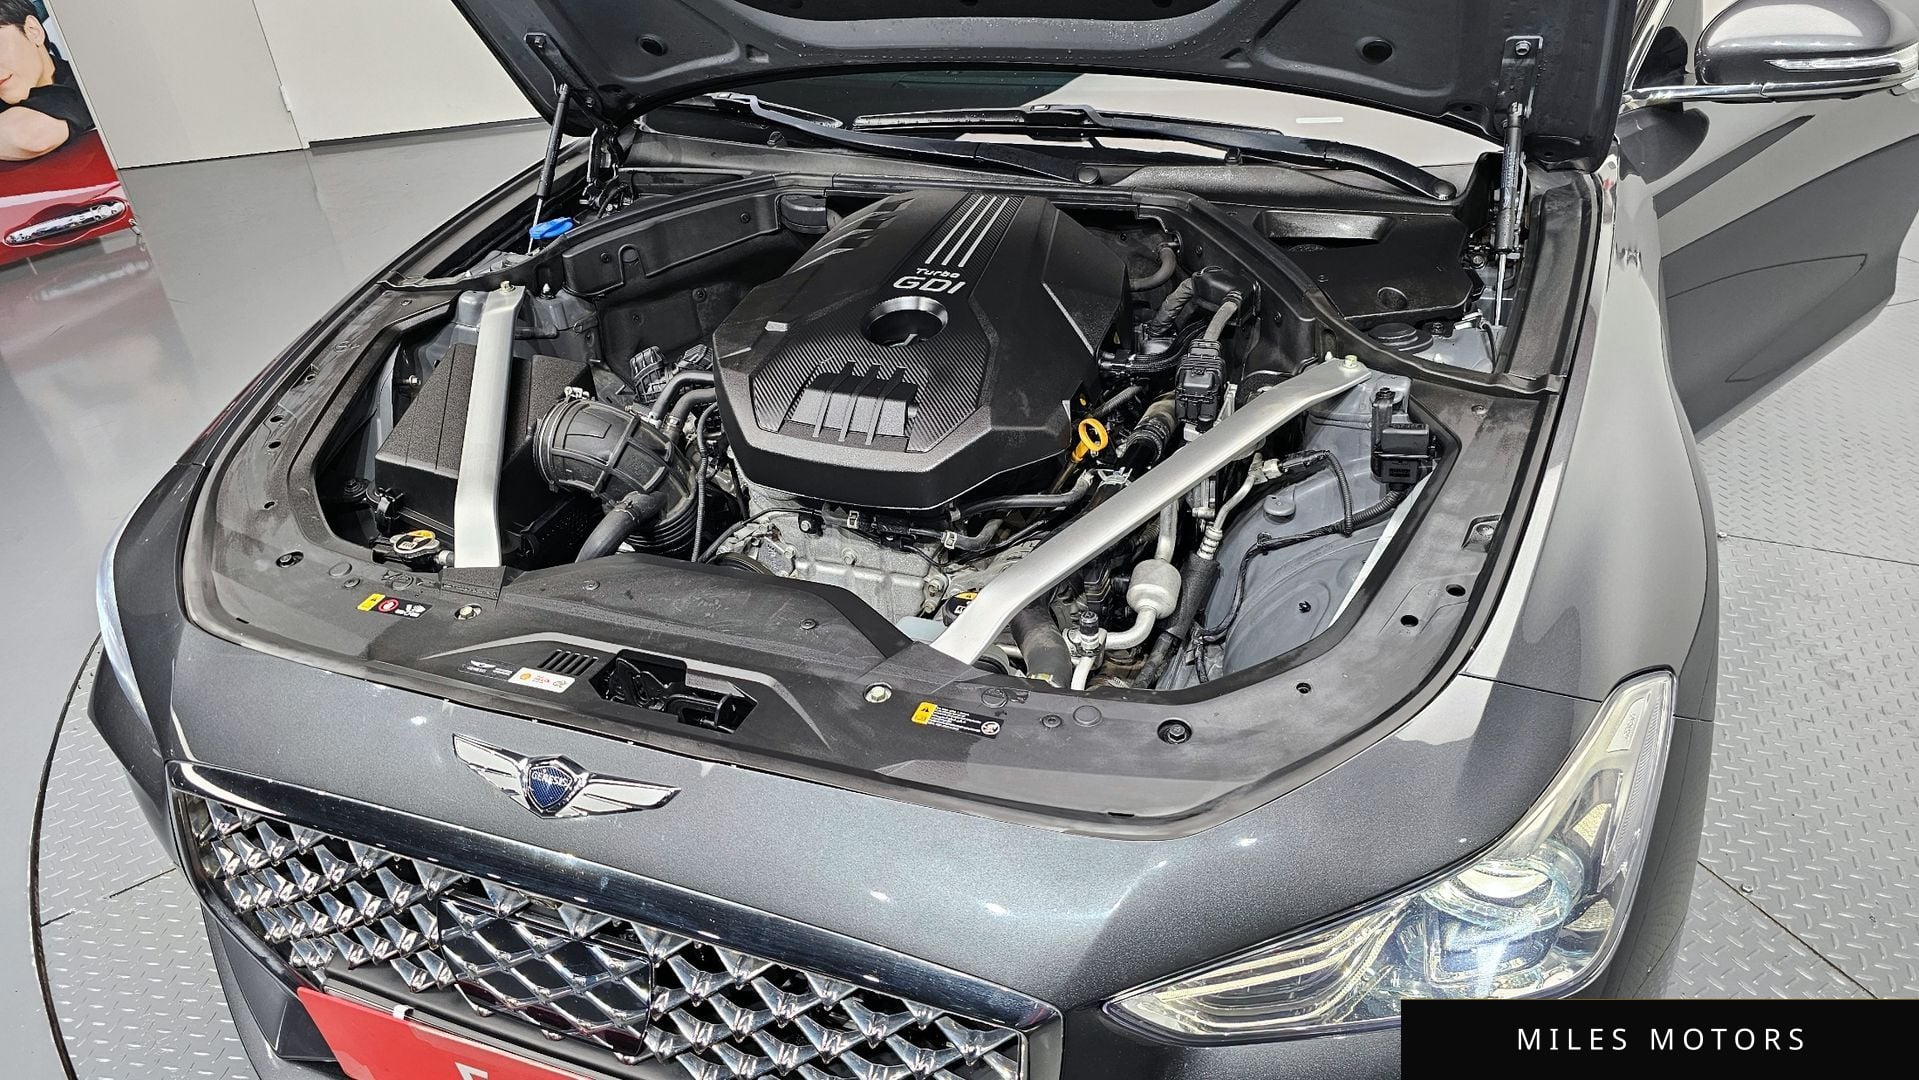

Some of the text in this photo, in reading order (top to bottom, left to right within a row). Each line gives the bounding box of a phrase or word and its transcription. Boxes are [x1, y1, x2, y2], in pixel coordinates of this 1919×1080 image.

[916, 268, 960, 278] Turbo
[893, 276, 966, 294] GDI
[532, 770, 569, 788] GENESIS
